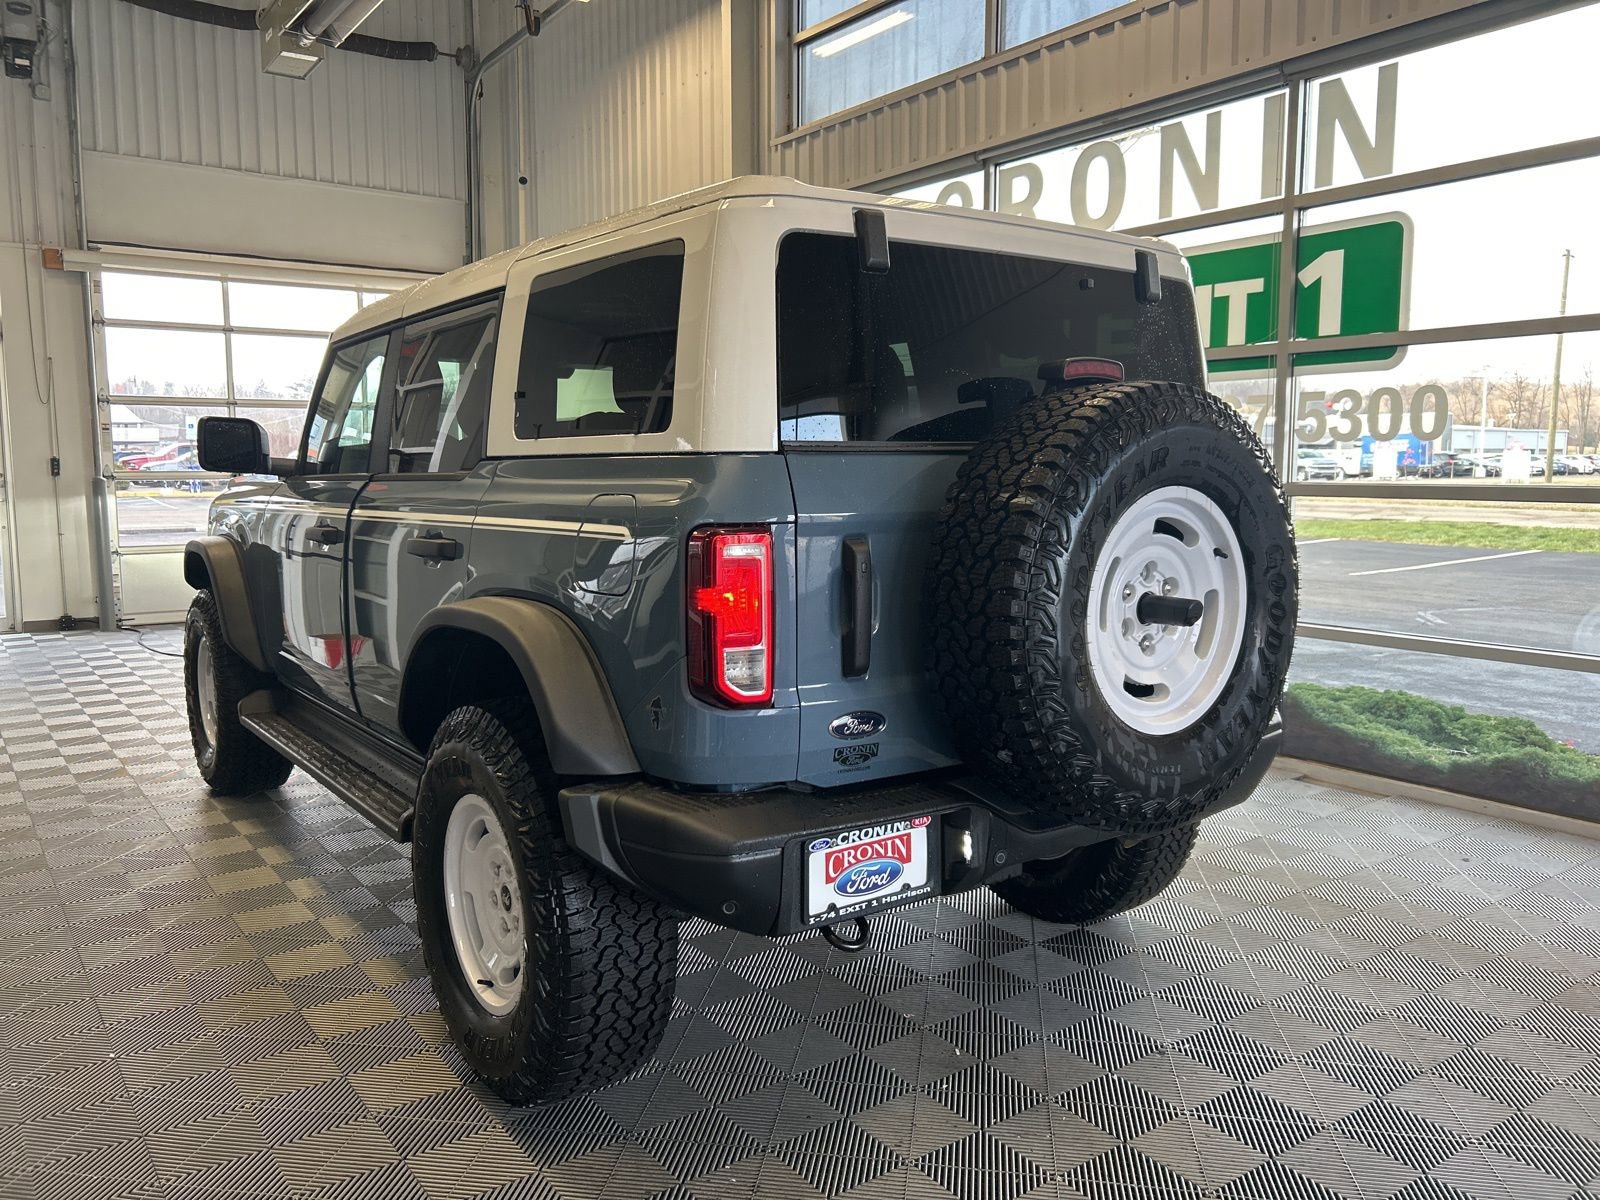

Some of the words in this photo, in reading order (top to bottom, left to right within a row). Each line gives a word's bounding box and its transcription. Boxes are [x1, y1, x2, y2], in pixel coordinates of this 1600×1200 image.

[1195, 277, 1265, 348] IT
[1297, 249, 1345, 337] 1
[834, 743, 878, 759] CRONIN
[837, 821, 905, 845] CRONIN
[914, 816, 929, 826] KIA
[828, 835, 908, 878] CRONIN
[846, 864, 892, 893] Ford
[808, 911, 837, 925] I-74
[839, 902, 868, 915] EXIT
[882, 886, 931, 904] Harrison
